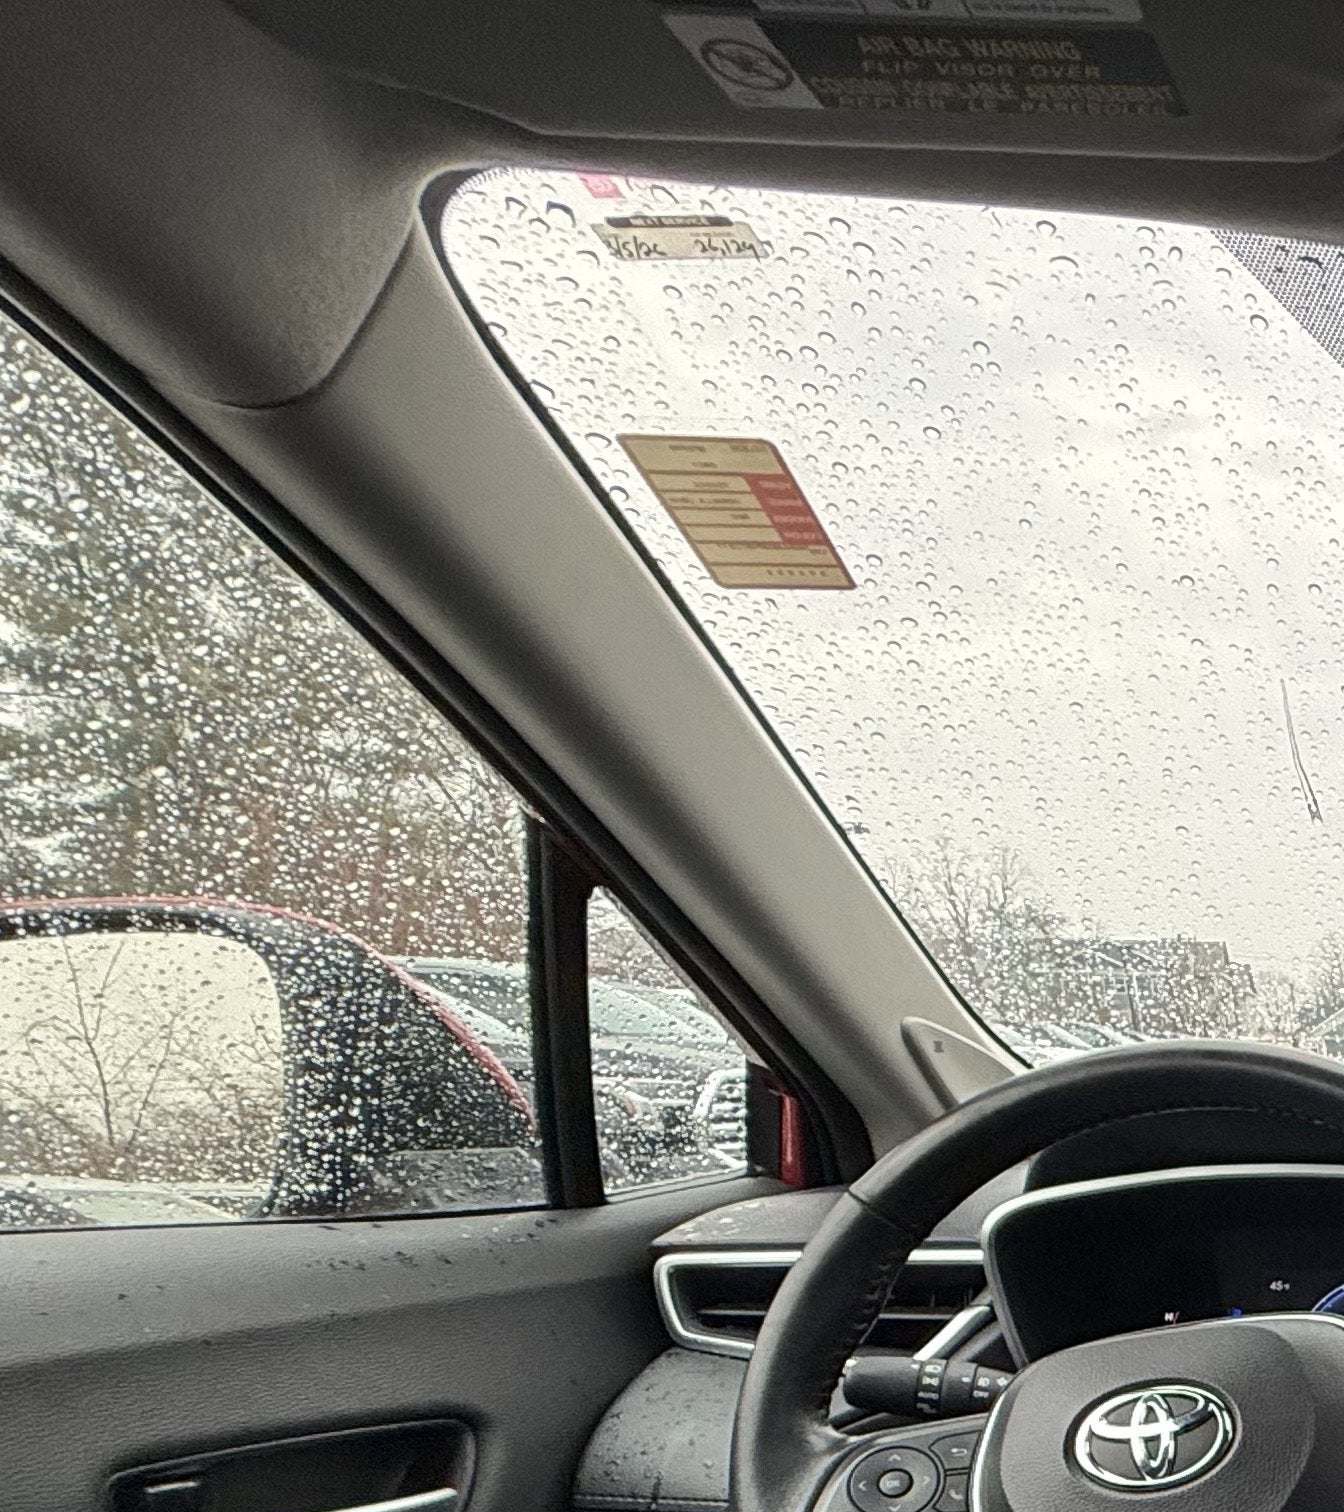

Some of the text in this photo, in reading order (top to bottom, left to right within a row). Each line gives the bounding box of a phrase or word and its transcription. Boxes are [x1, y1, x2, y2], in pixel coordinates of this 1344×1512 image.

[857, 35, 1082, 61] AIR BAG WARNING
[862, 61, 1101, 79] FLIP VISOR OVER
[917, 1391, 938, 1400] AUTO
[972, 1390, 990, 1399] OFF
